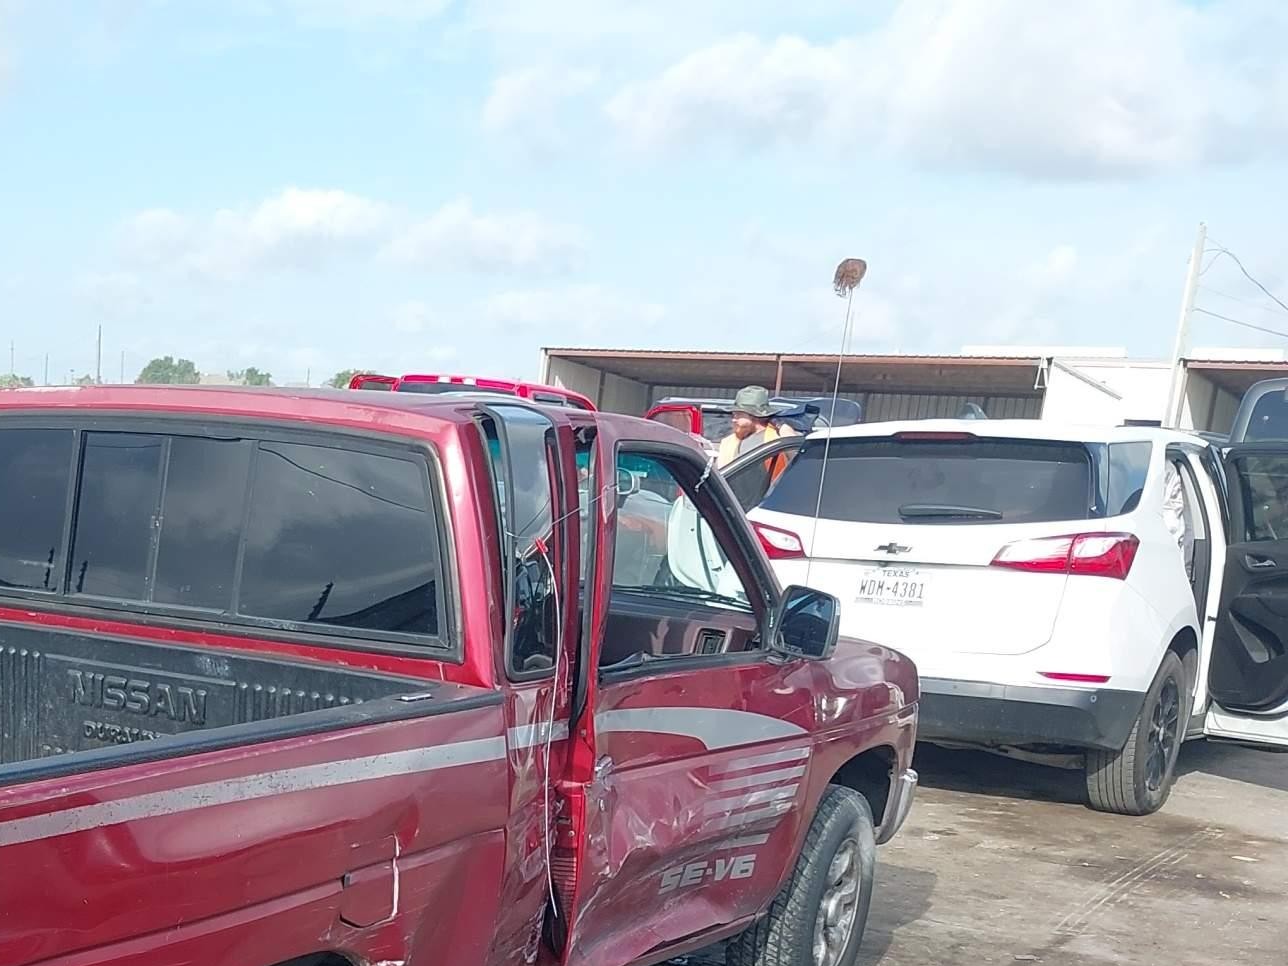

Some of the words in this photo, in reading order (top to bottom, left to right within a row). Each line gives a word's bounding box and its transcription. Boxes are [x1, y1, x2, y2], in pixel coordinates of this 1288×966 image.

[882, 569, 910, 578] TEXAS
[67, 669, 207, 725] NISSAN
[657, 854, 757, 895] SE-V6
